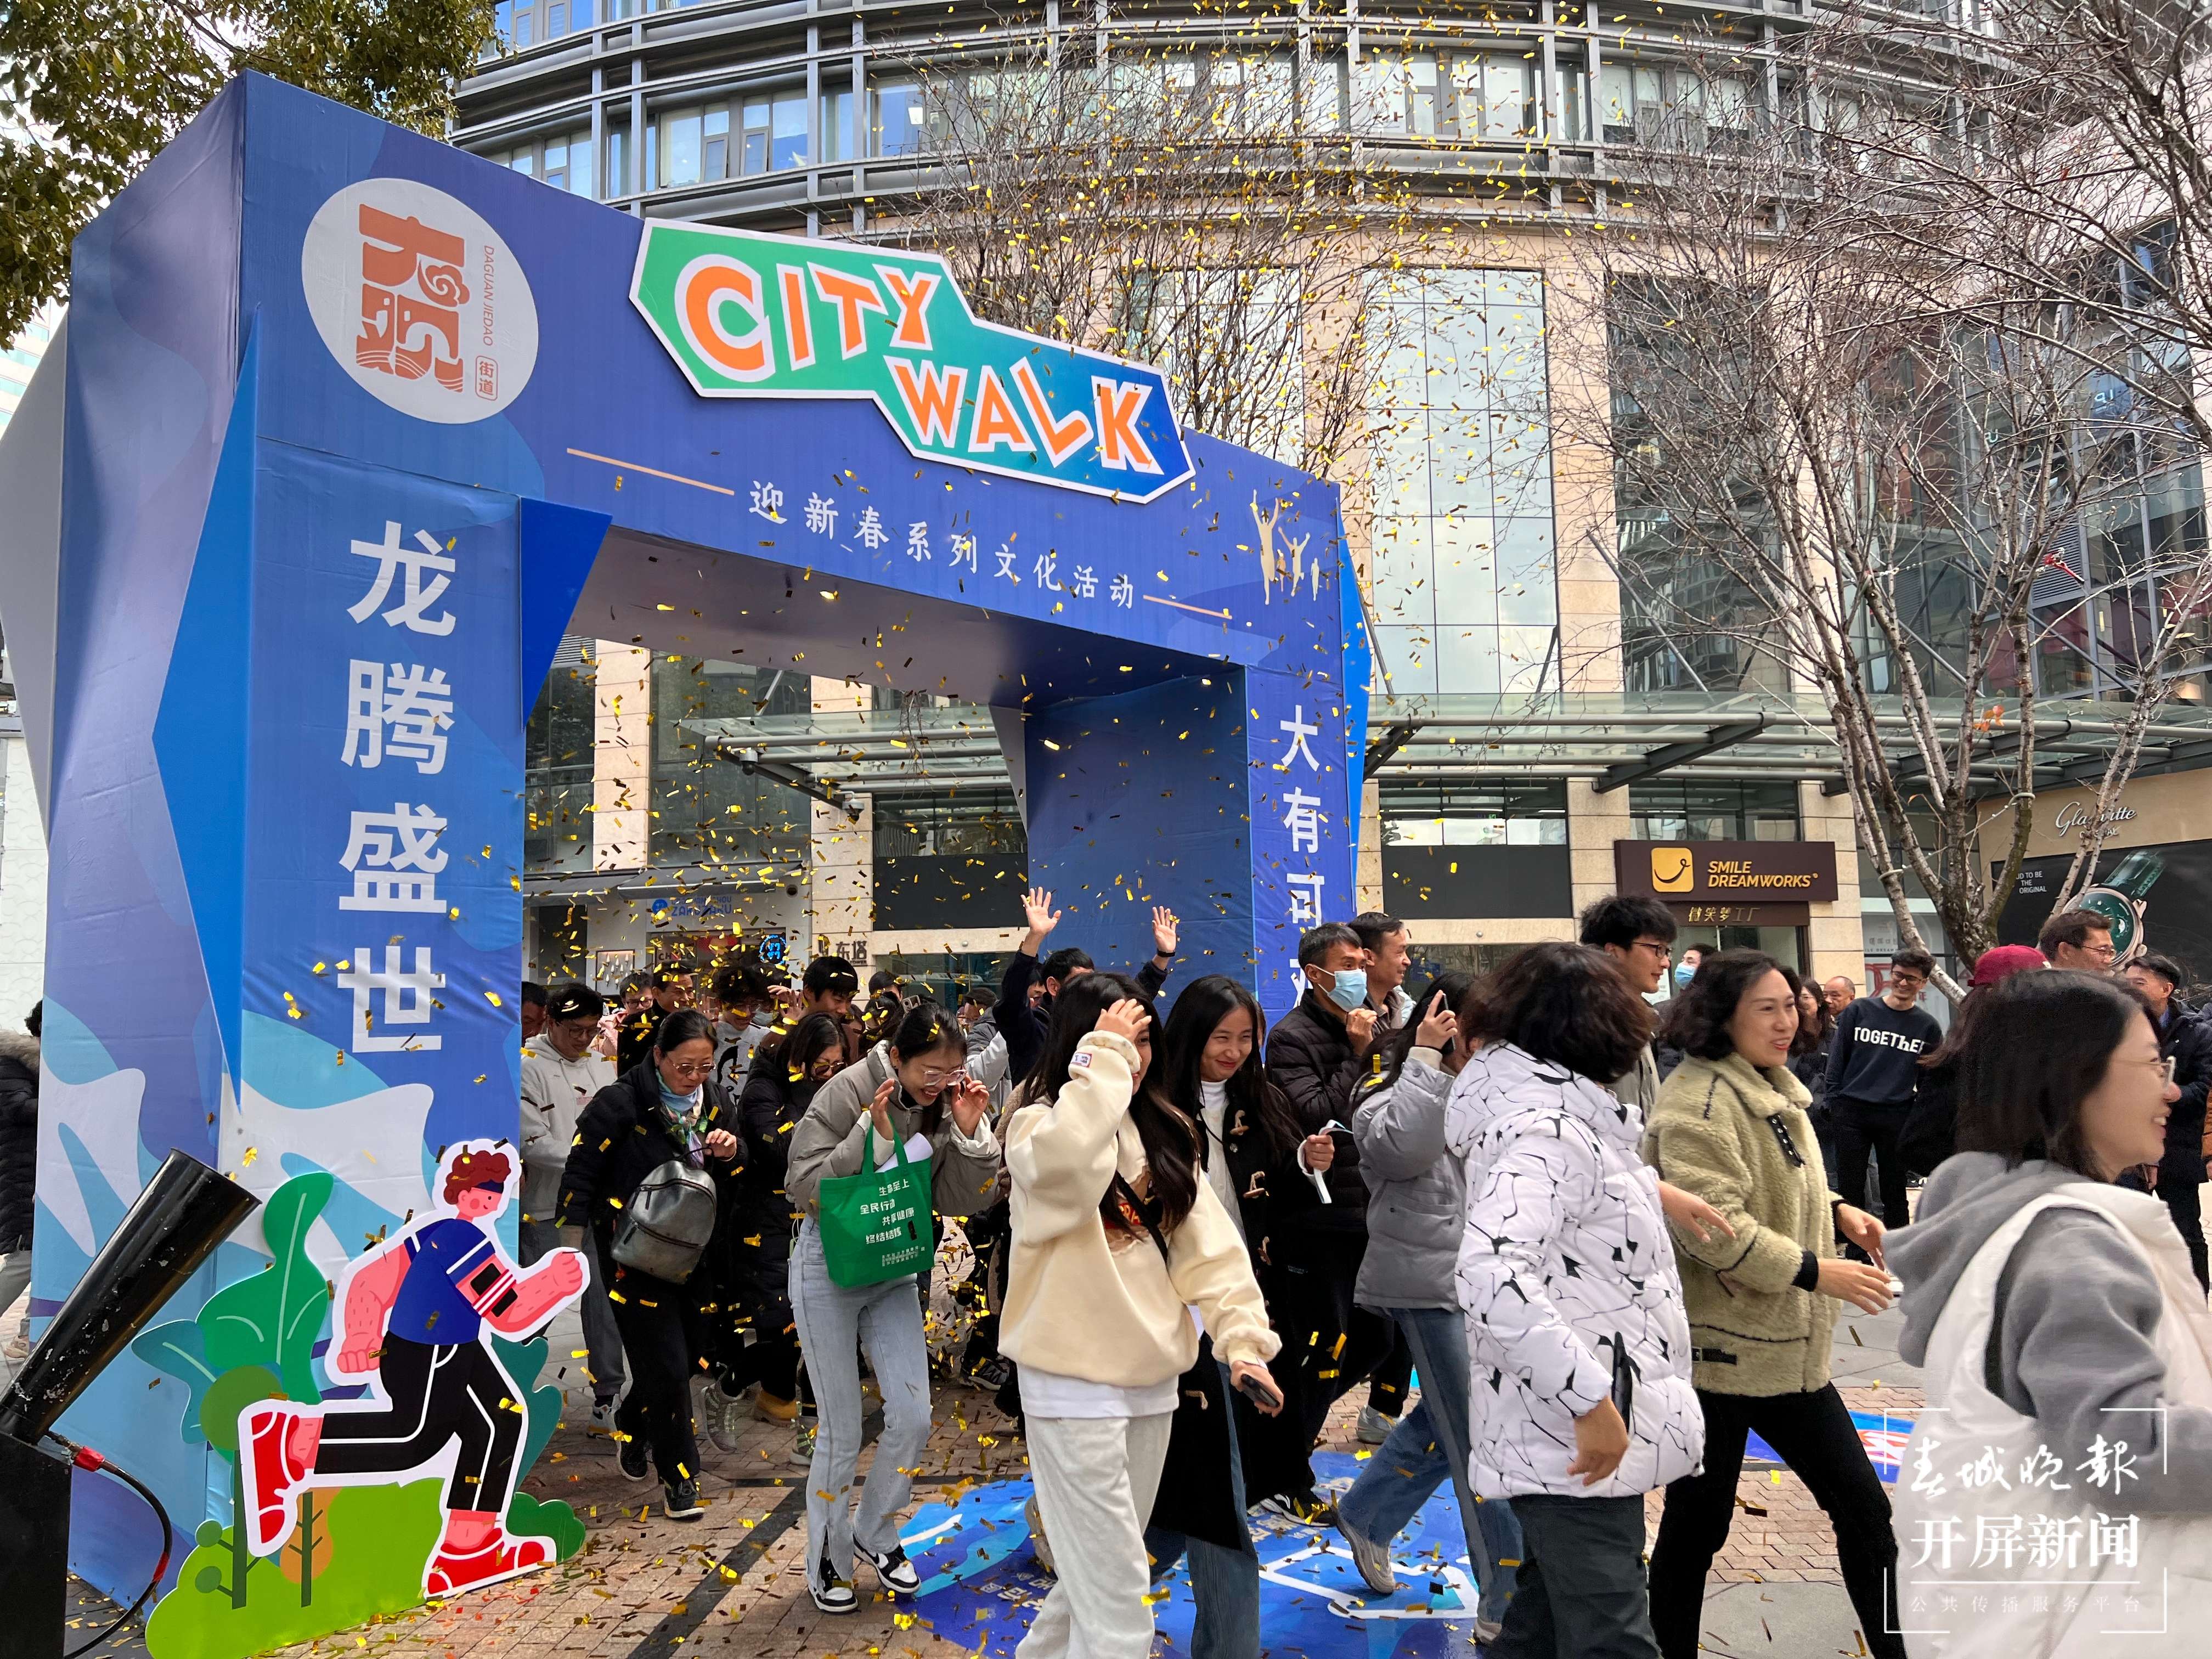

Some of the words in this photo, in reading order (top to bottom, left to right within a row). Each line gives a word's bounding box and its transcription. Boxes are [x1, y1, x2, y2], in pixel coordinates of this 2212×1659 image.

[484, 245, 494, 301] DAGUAN
[483, 302, 493, 346] JIEDAO
[676, 255, 939, 382] CITY
[479, 360, 494, 396] 街道
[884, 356, 1163, 474] WALK
[749, 480, 1134, 609] 迎新春系列文化活动
[338, 520, 456, 1053] 龙腾盛世
[1708, 861, 1752, 873] SMILE
[1708, 874, 1812, 887] DREAMWORKS
[2019, 885, 2047, 894] ORIGINAL
